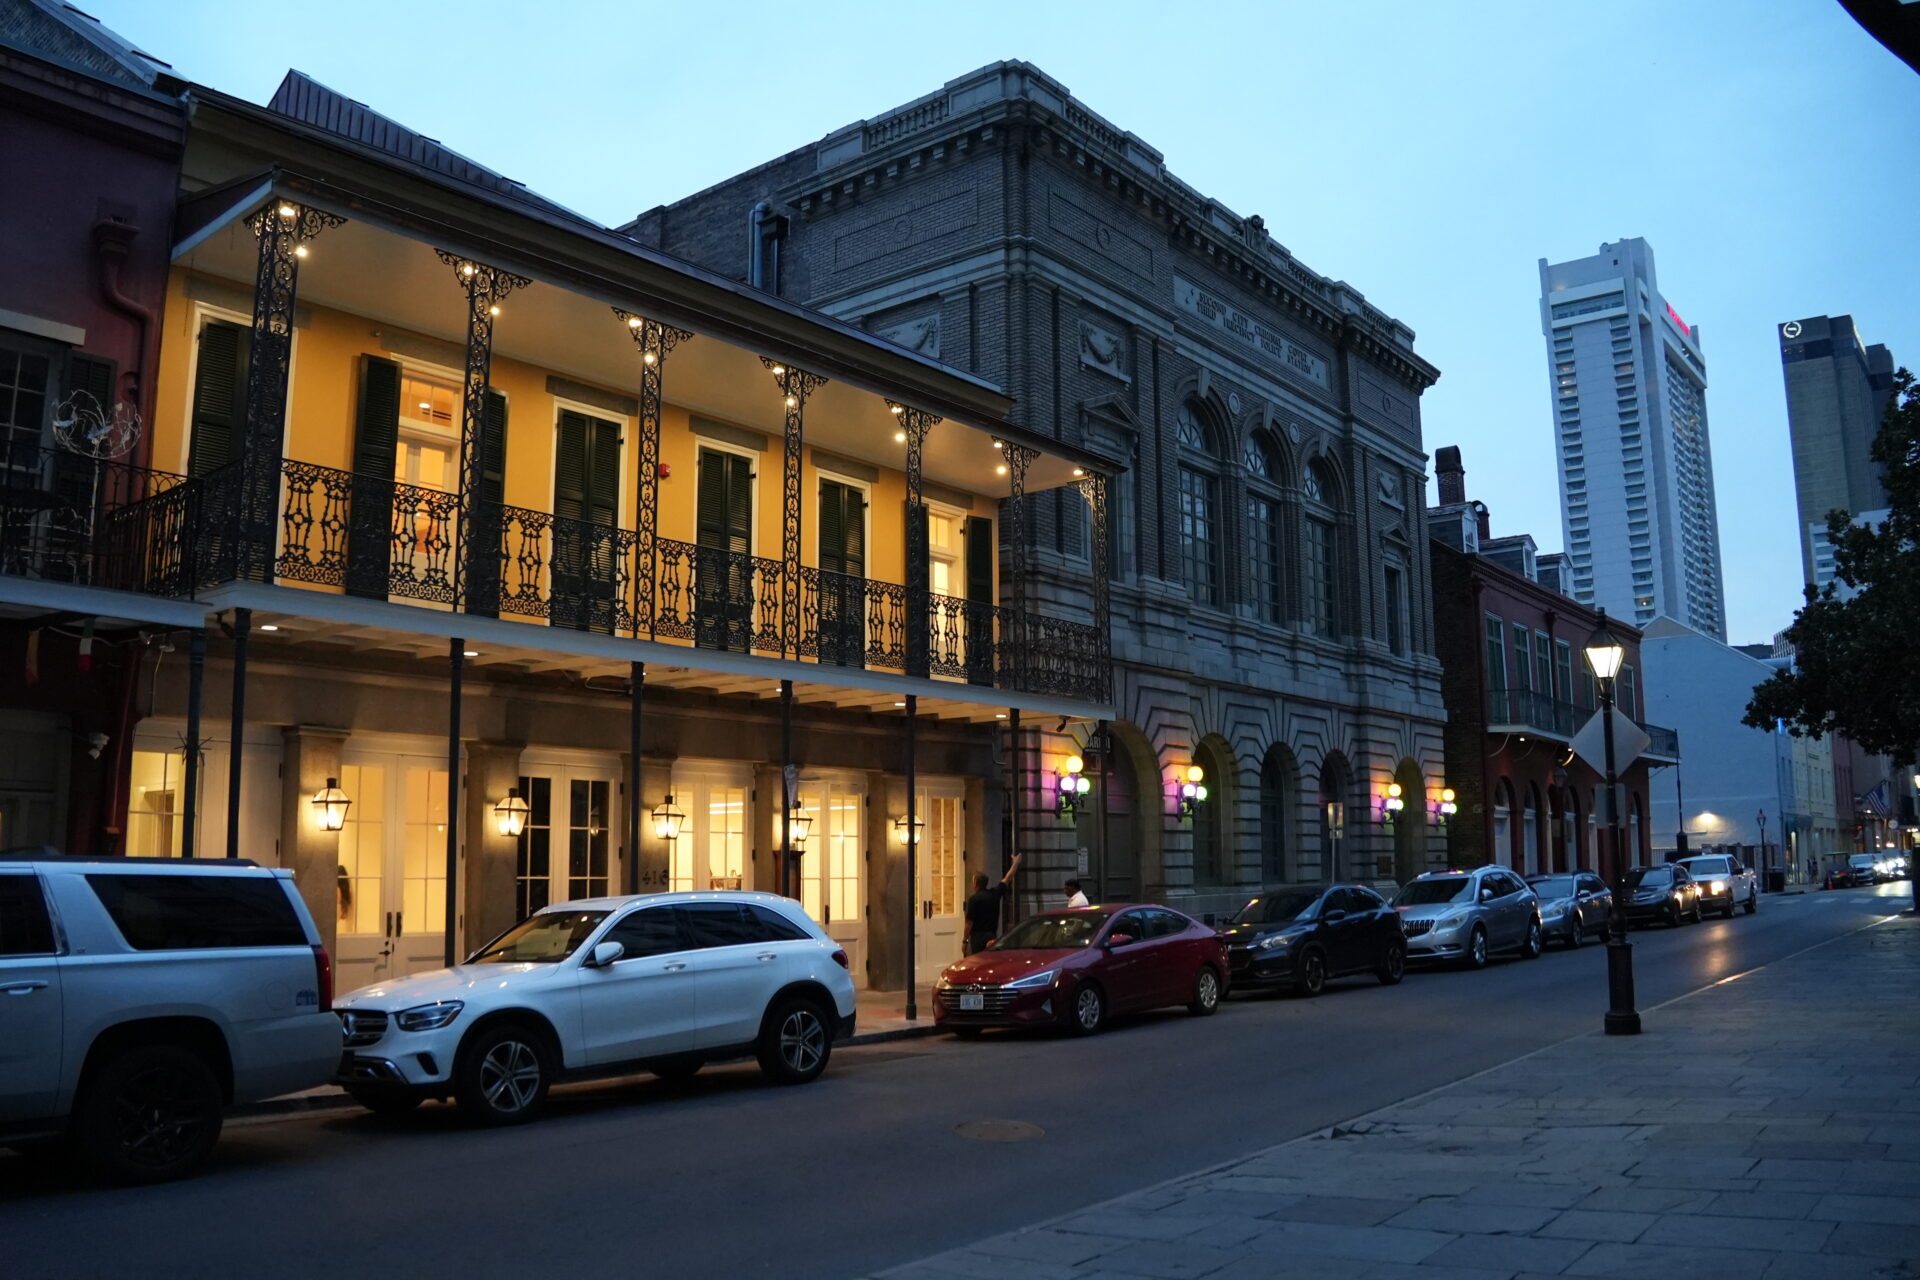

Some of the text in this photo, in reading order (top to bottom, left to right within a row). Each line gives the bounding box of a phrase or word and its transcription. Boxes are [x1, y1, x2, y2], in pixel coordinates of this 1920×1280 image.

[1196, 302, 1311, 375] THIRD PRECINCT POLICE STATION
[1199, 292, 1227, 315] SECOND
[1232, 312, 1249, 328] CITY
[1254, 325, 1283, 348] CRIMINAL
